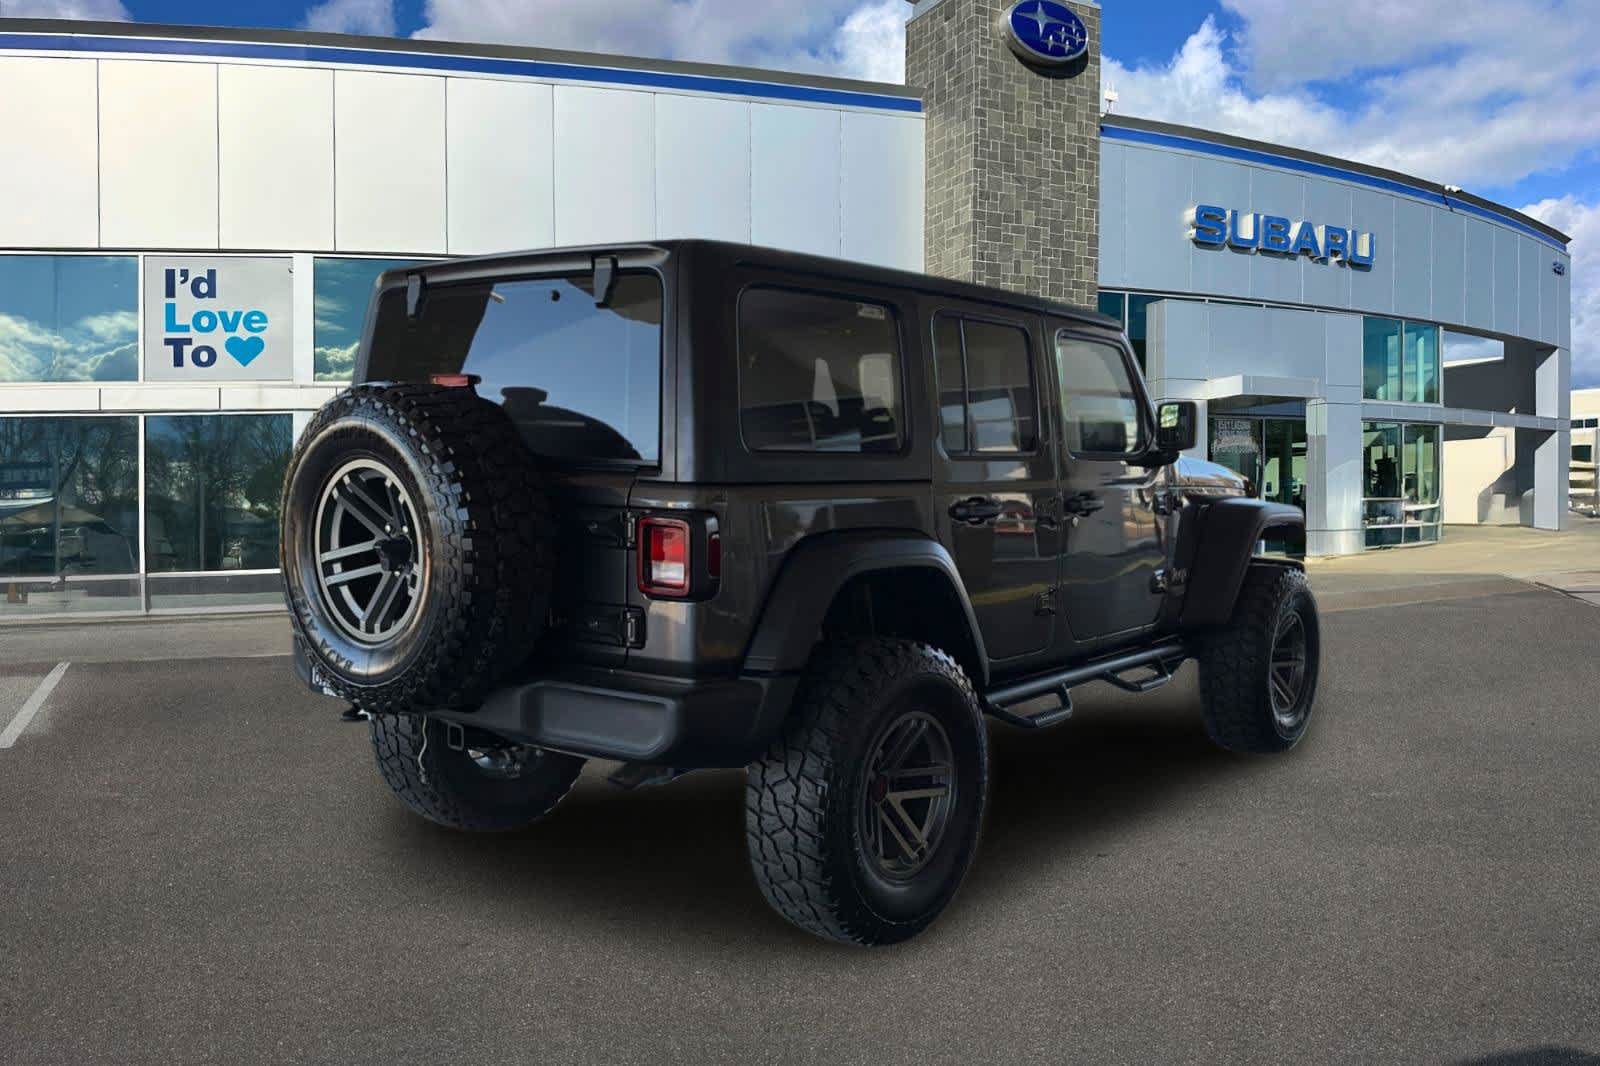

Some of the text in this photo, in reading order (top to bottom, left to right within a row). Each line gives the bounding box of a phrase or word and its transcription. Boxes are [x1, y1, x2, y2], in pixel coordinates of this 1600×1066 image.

[1193, 204, 1375, 270] SUBARU
[165, 269, 216, 298] I’d
[165, 303, 268, 333] Love
[164, 338, 217, 367] To
